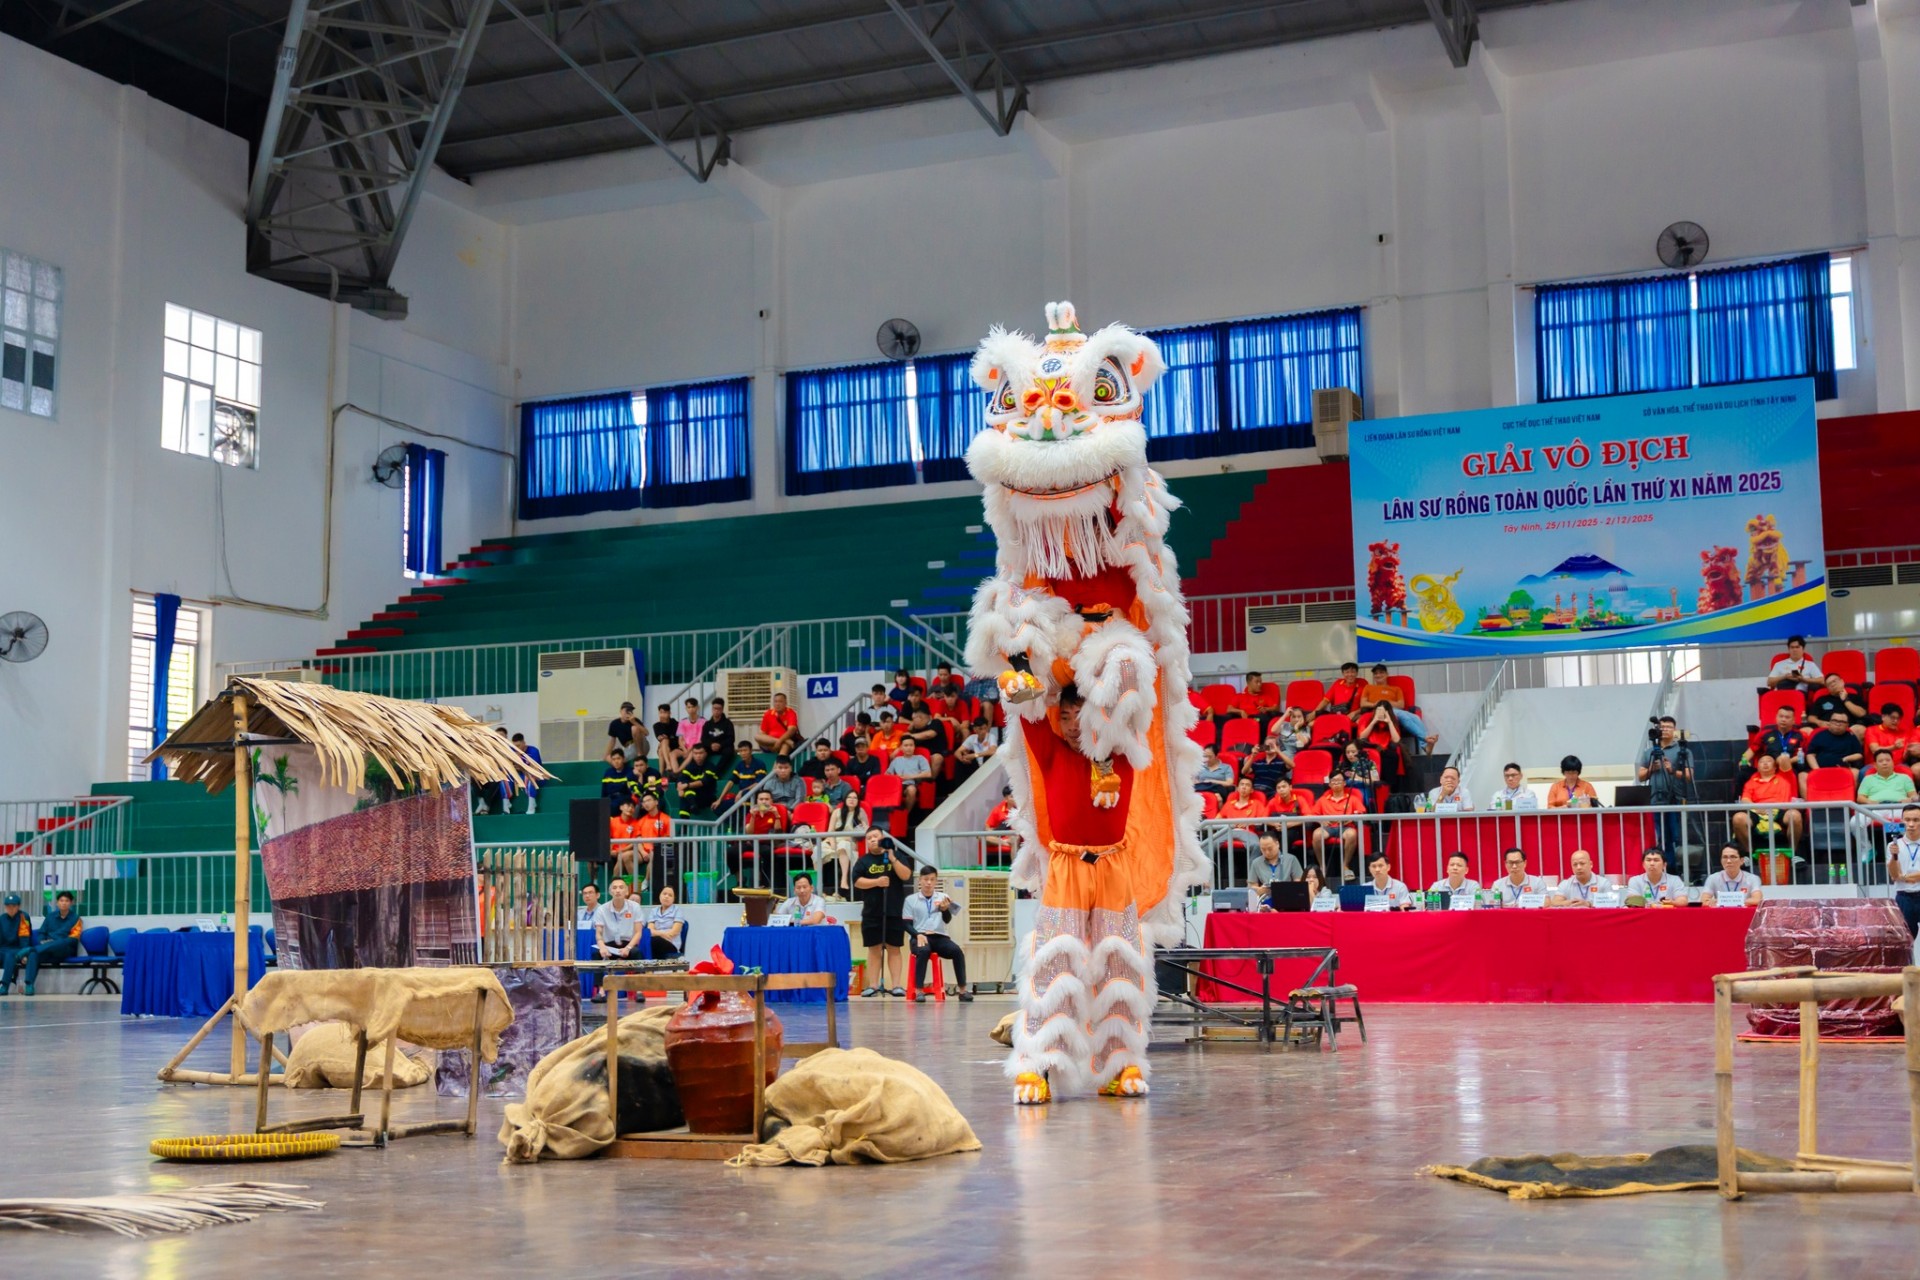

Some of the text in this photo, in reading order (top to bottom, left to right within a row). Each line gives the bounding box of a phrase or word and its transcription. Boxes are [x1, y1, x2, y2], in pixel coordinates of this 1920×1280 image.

[1696, 402, 1713, 411] THAO
[1724, 400, 1733, 409] DU
[1502, 421, 1515, 430] CỤC
[1554, 416, 1571, 425] THAO
[1571, 413, 1585, 424] VIỆT
[1586, 413, 1601, 422] NAM
[1432, 426, 1446, 437] VIỆT
[1447, 425, 1460, 434] NAM
[1462, 435, 1690, 477] GIẢI VÔ ĐỊCH
[1384, 471, 1781, 520] LÂN SƯ RỒNG TOÀN QUỐC LẦN THỨ XI NĂM 2025
[1503, 525, 1518, 534] Tây
[1545, 517, 1598, 530] 25/11/2025
[1605, 513, 1654, 526] 2/12/2025
[812, 680, 834, 695] A4
